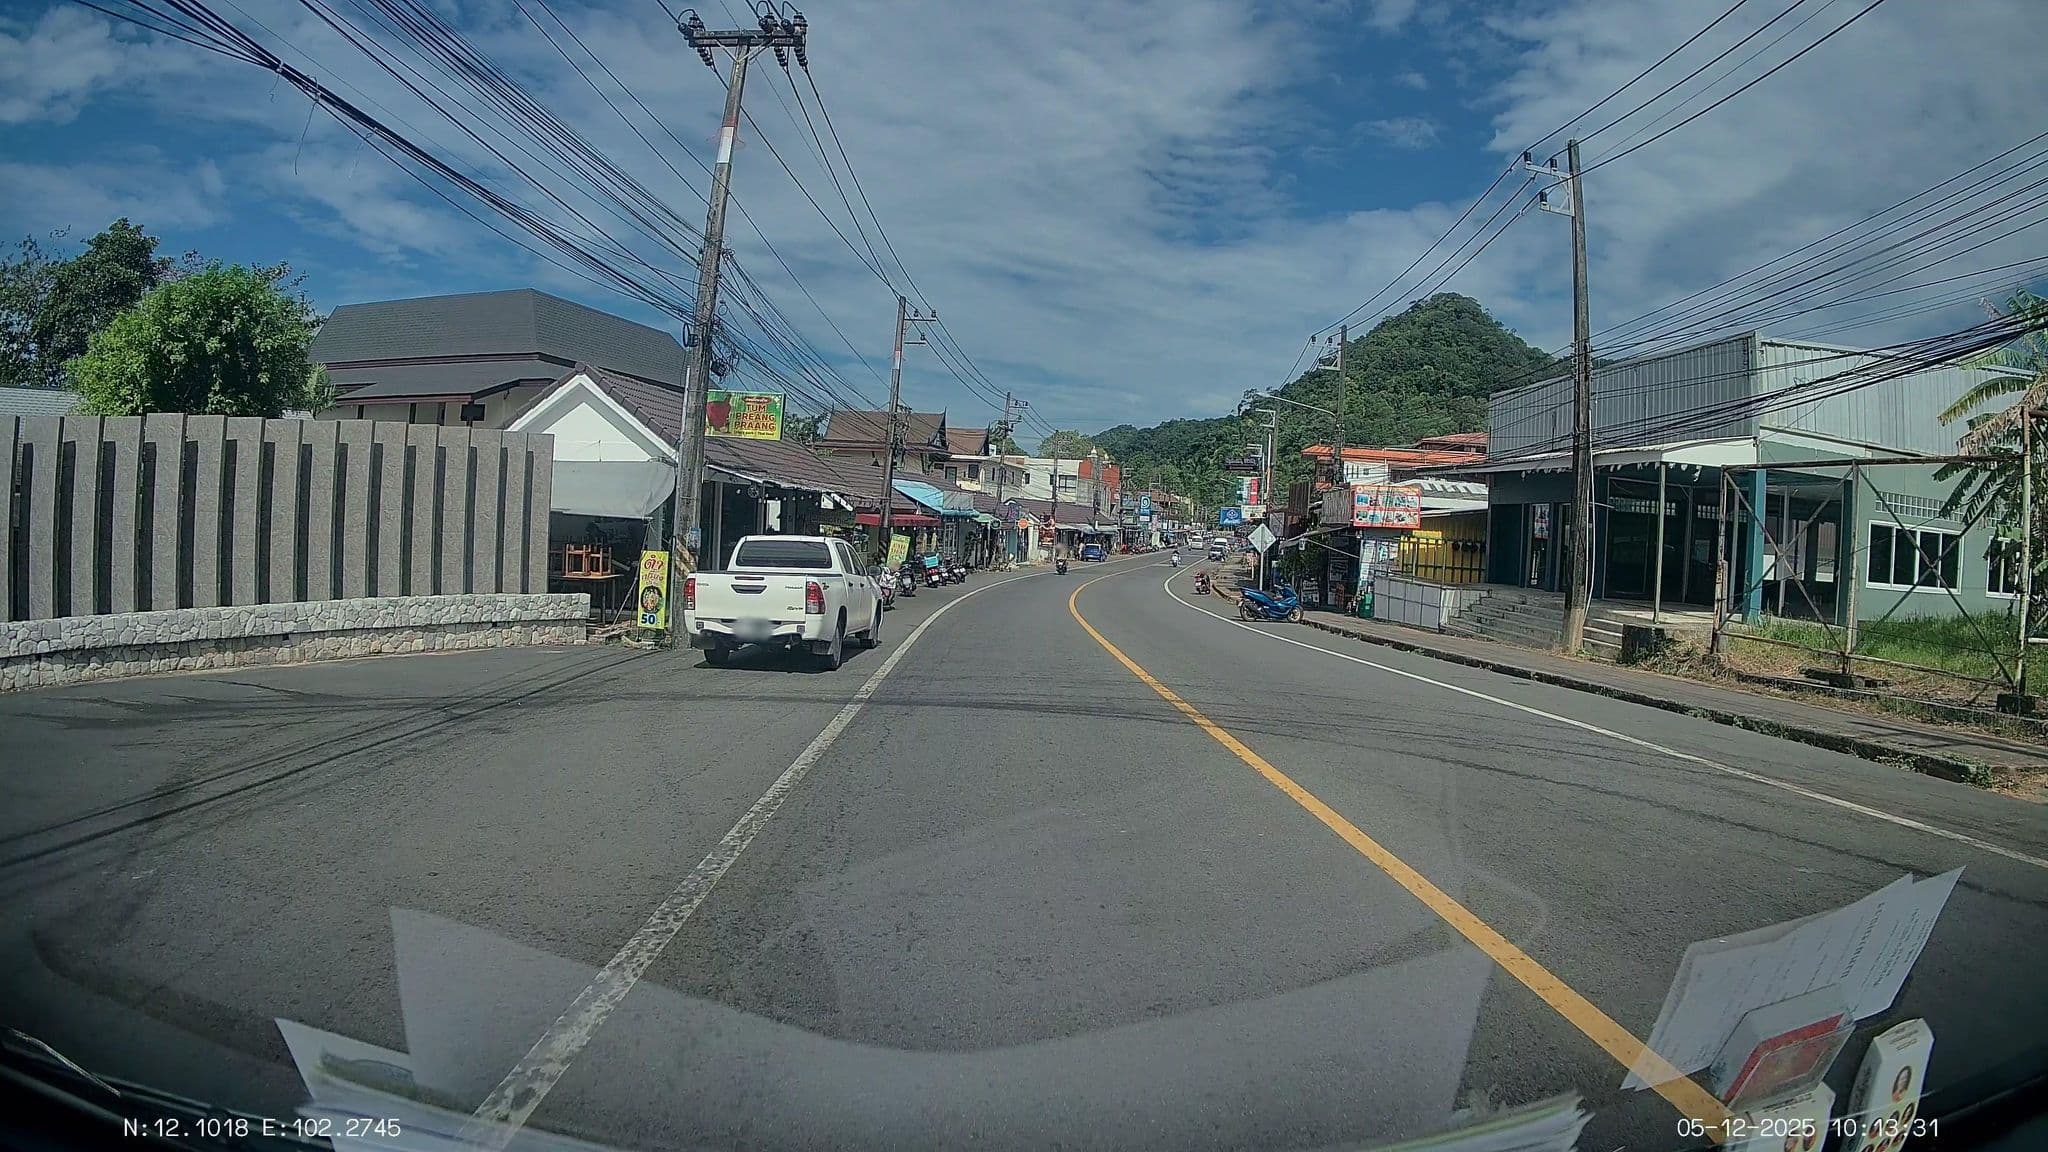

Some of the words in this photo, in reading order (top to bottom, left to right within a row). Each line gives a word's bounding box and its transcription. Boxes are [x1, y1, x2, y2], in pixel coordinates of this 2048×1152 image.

[747, 404, 766, 412] TUM
[735, 412, 776, 422] PREANG
[734, 421, 776, 431] PRAANG
